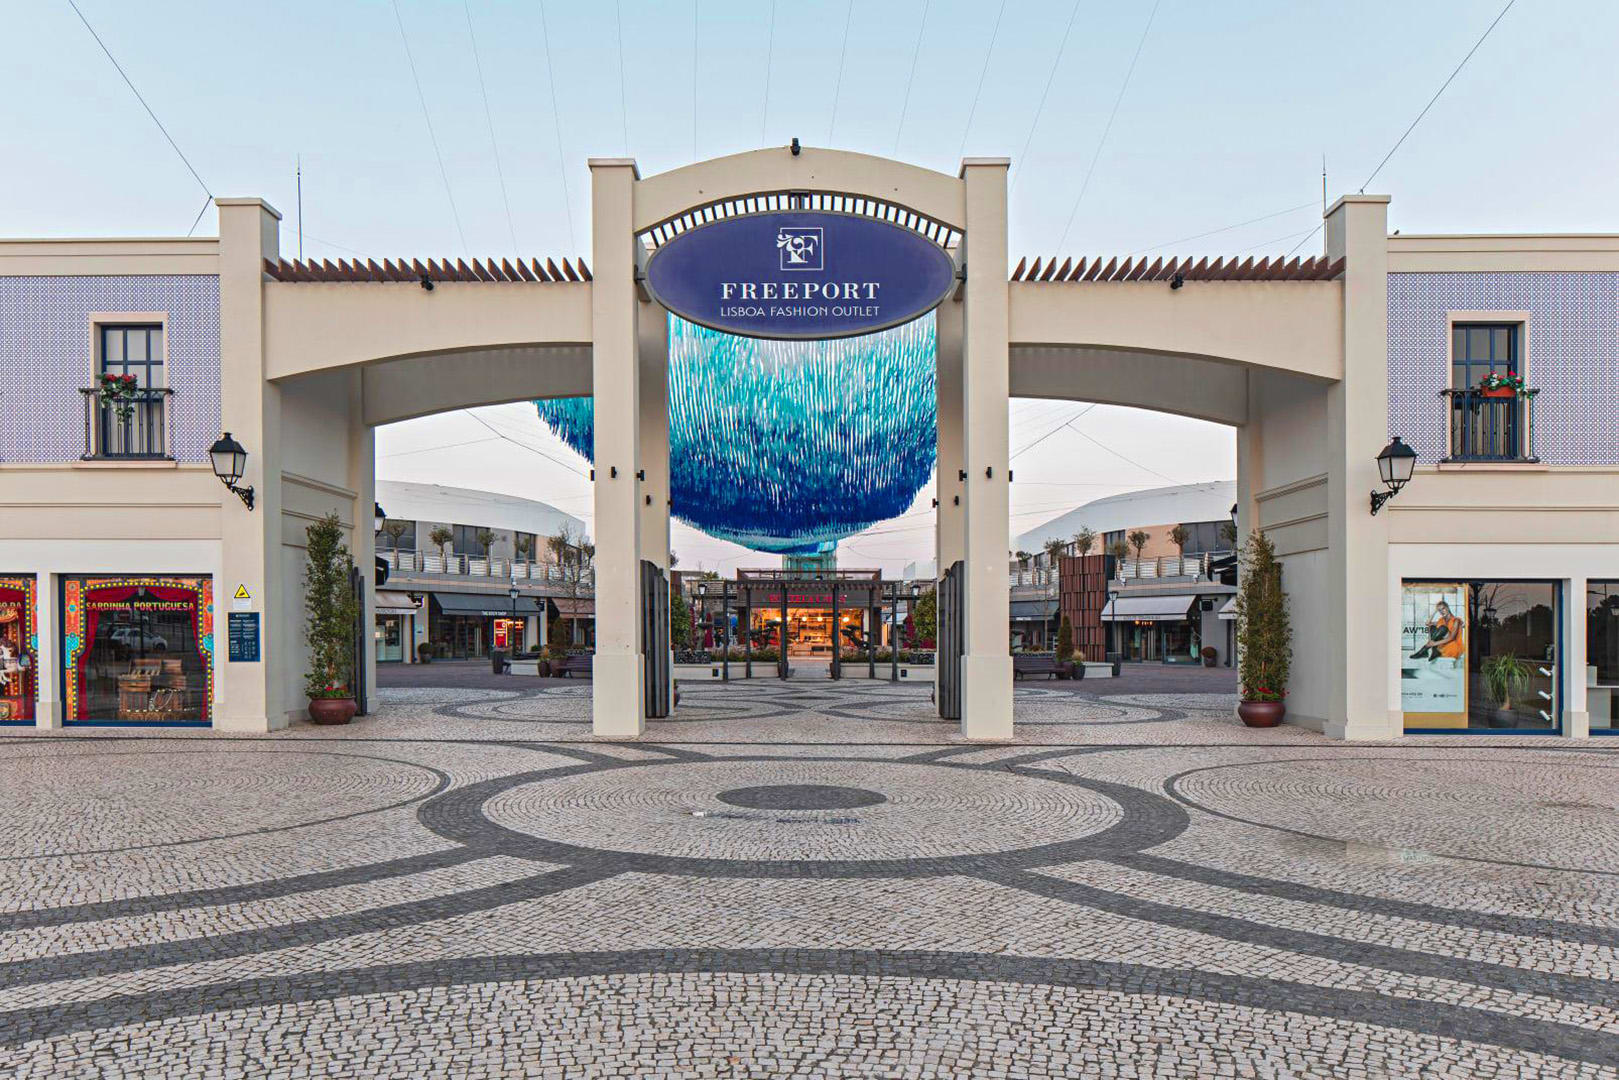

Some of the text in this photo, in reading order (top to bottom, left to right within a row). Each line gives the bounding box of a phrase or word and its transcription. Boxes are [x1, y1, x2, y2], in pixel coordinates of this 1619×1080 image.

[720, 282, 880, 300] FREEPORT
[720, 306, 880, 317] LISBOA FASHION OUTLET
[86, 602, 194, 611] SARDINHA PORTUGUESA
